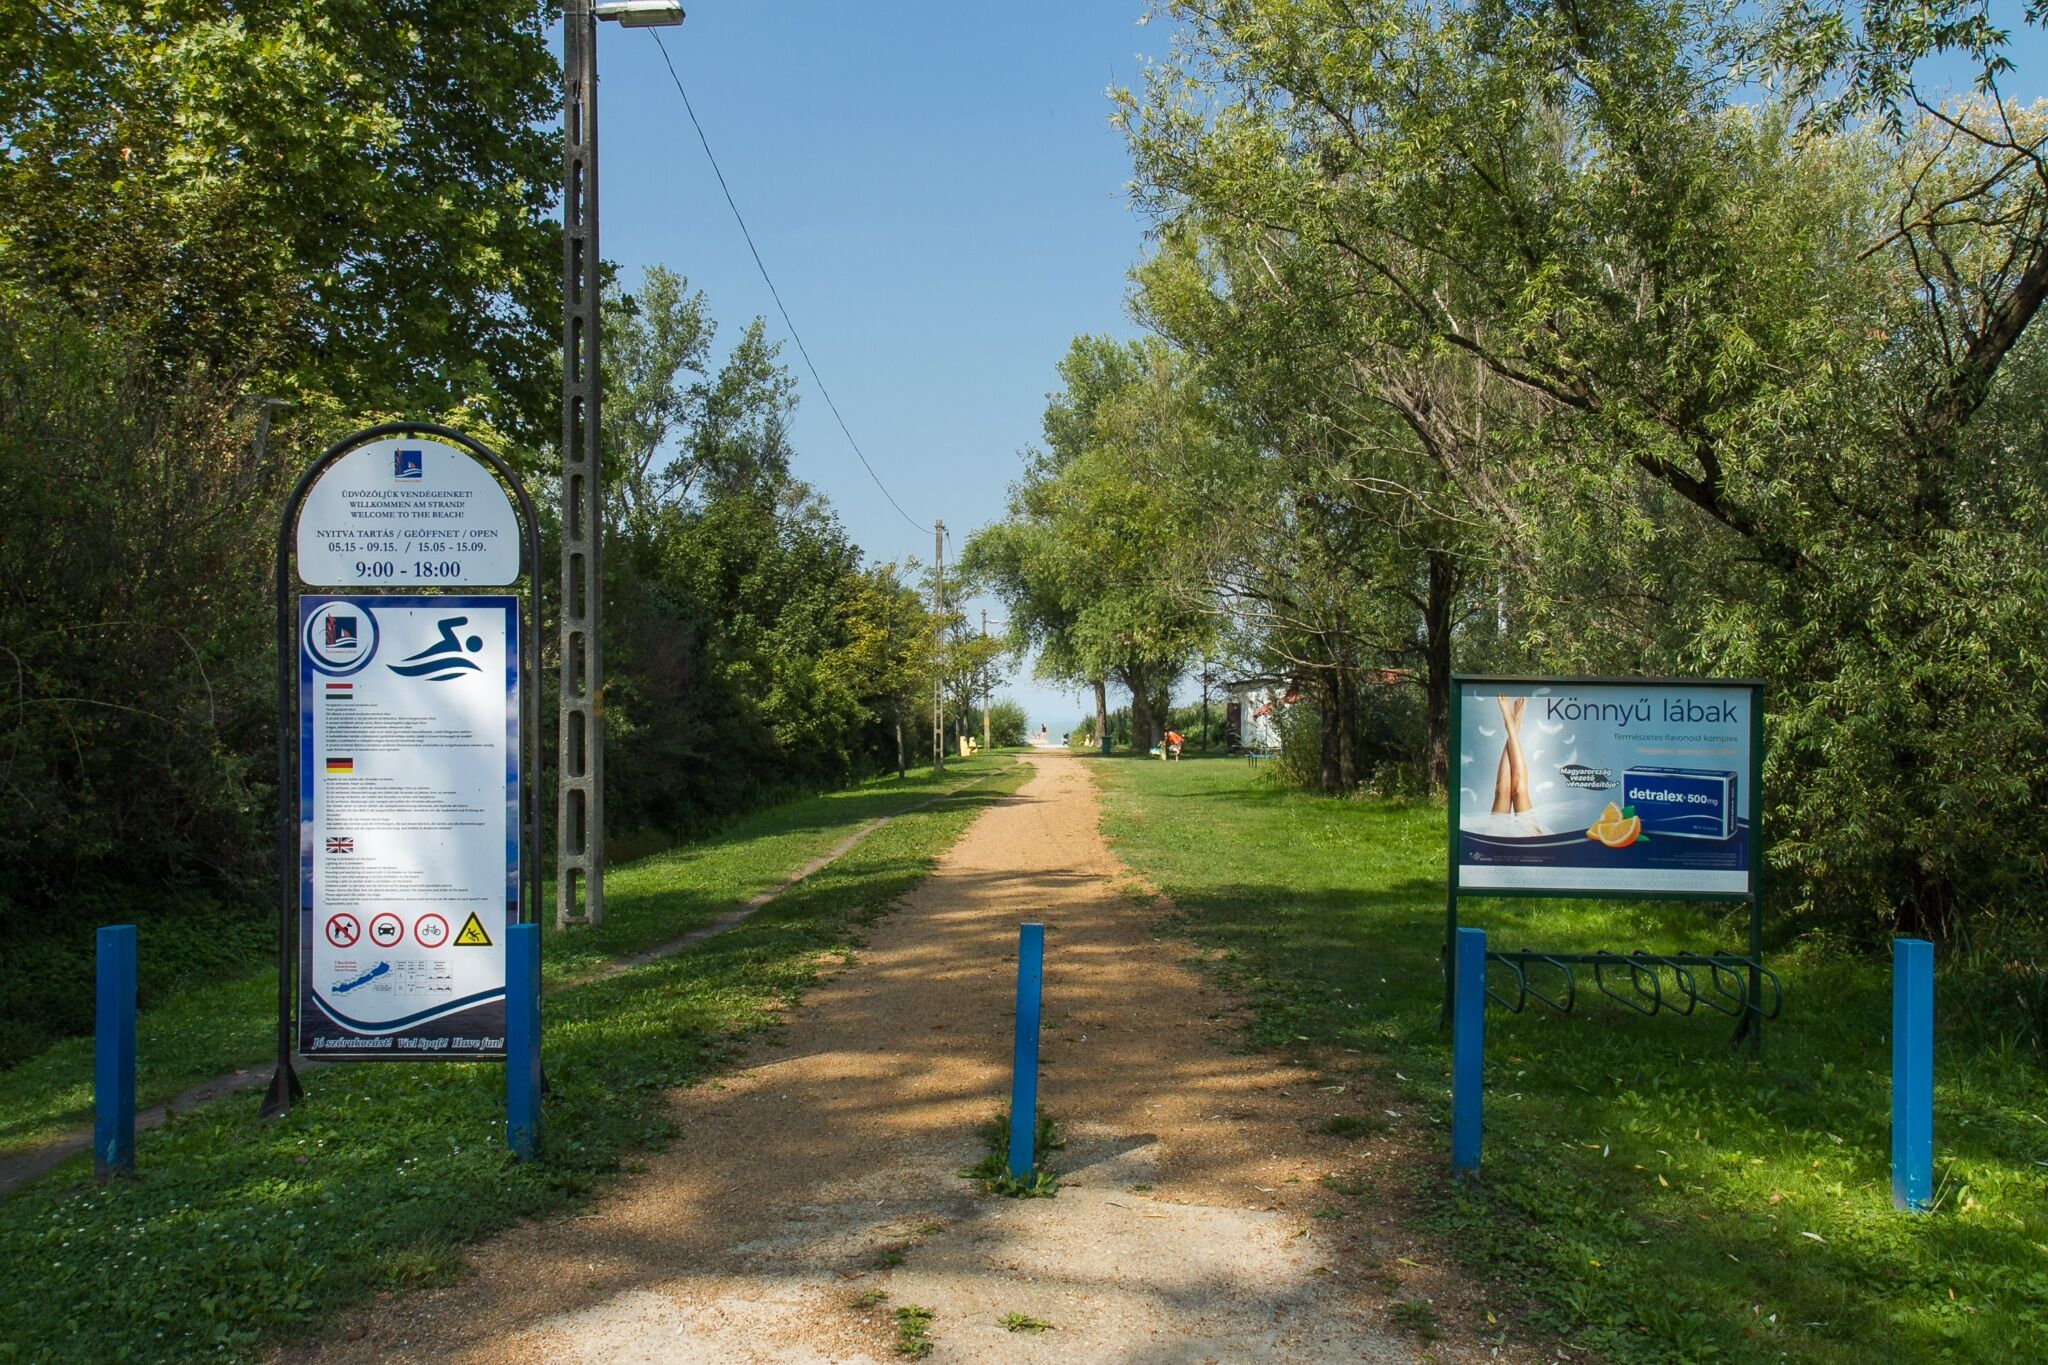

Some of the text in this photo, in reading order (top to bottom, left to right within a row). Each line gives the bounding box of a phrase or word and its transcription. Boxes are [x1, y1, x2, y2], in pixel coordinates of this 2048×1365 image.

[401, 490, 472, 498] VENDÉGEINKET!
[317, 530, 355, 538] NYITVA
[358, 529, 394, 538] TARTÁS
[404, 529, 459, 538] GEÖFFNET
[470, 530, 498, 538] OPEN
[329, 542, 356, 552] 05.15
[367, 542, 397, 552] 09.15.
[404, 542, 411, 553] /
[419, 542, 445, 552] 15.05
[457, 542, 486, 552] 15.09.
[356, 561, 394, 578] 9:00
[414, 561, 460, 578] 18:00
[1547, 697, 1737, 727] Könnyű lábak
[1614, 733, 1738, 744] Természetes flavonoid komplex
[1560, 767, 1612, 778] Magyarország
[451, 1038, 480, 1048] Have
[480, 1038, 504, 1049] fun!
